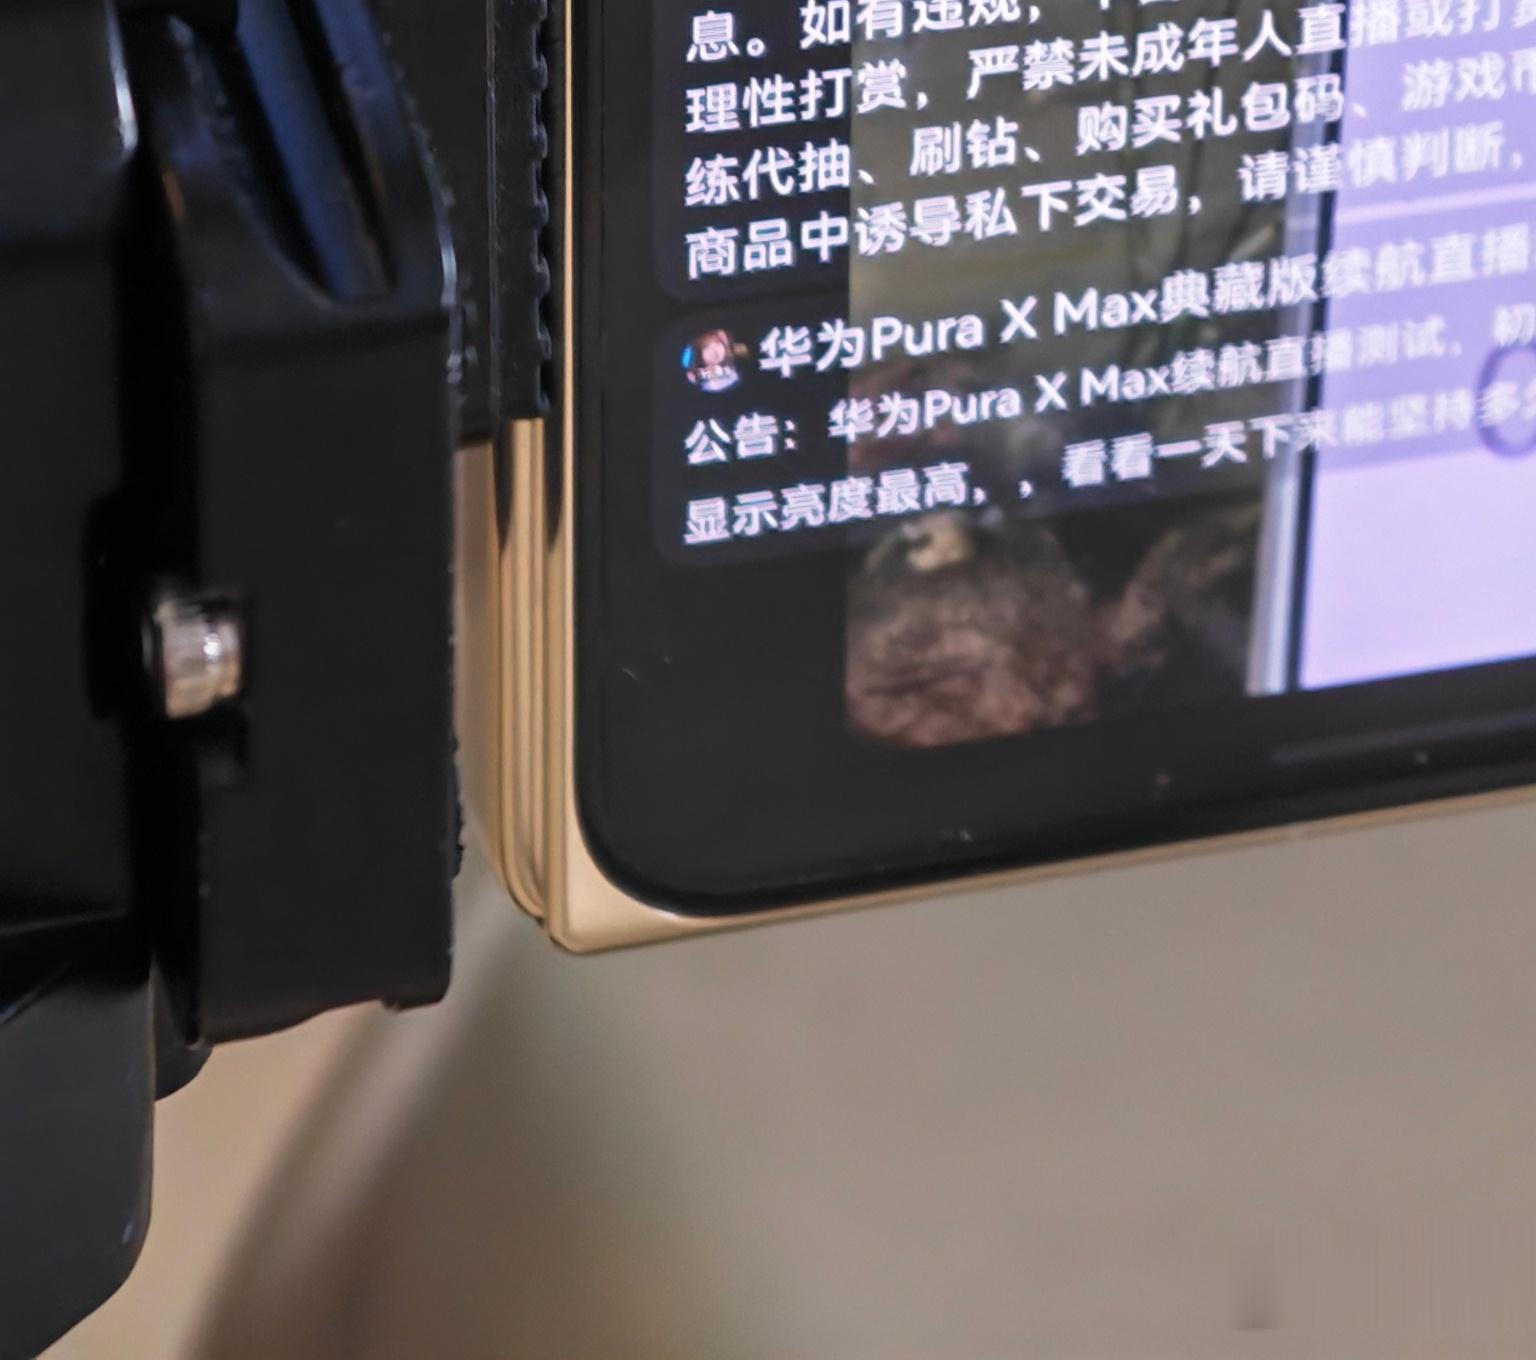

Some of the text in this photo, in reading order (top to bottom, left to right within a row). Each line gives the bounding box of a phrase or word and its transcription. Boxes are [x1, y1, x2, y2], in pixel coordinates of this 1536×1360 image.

[759, 313, 984, 378] 华为Pura
[1000, 294, 1038, 344] X
[1033, 371, 1068, 414] X
